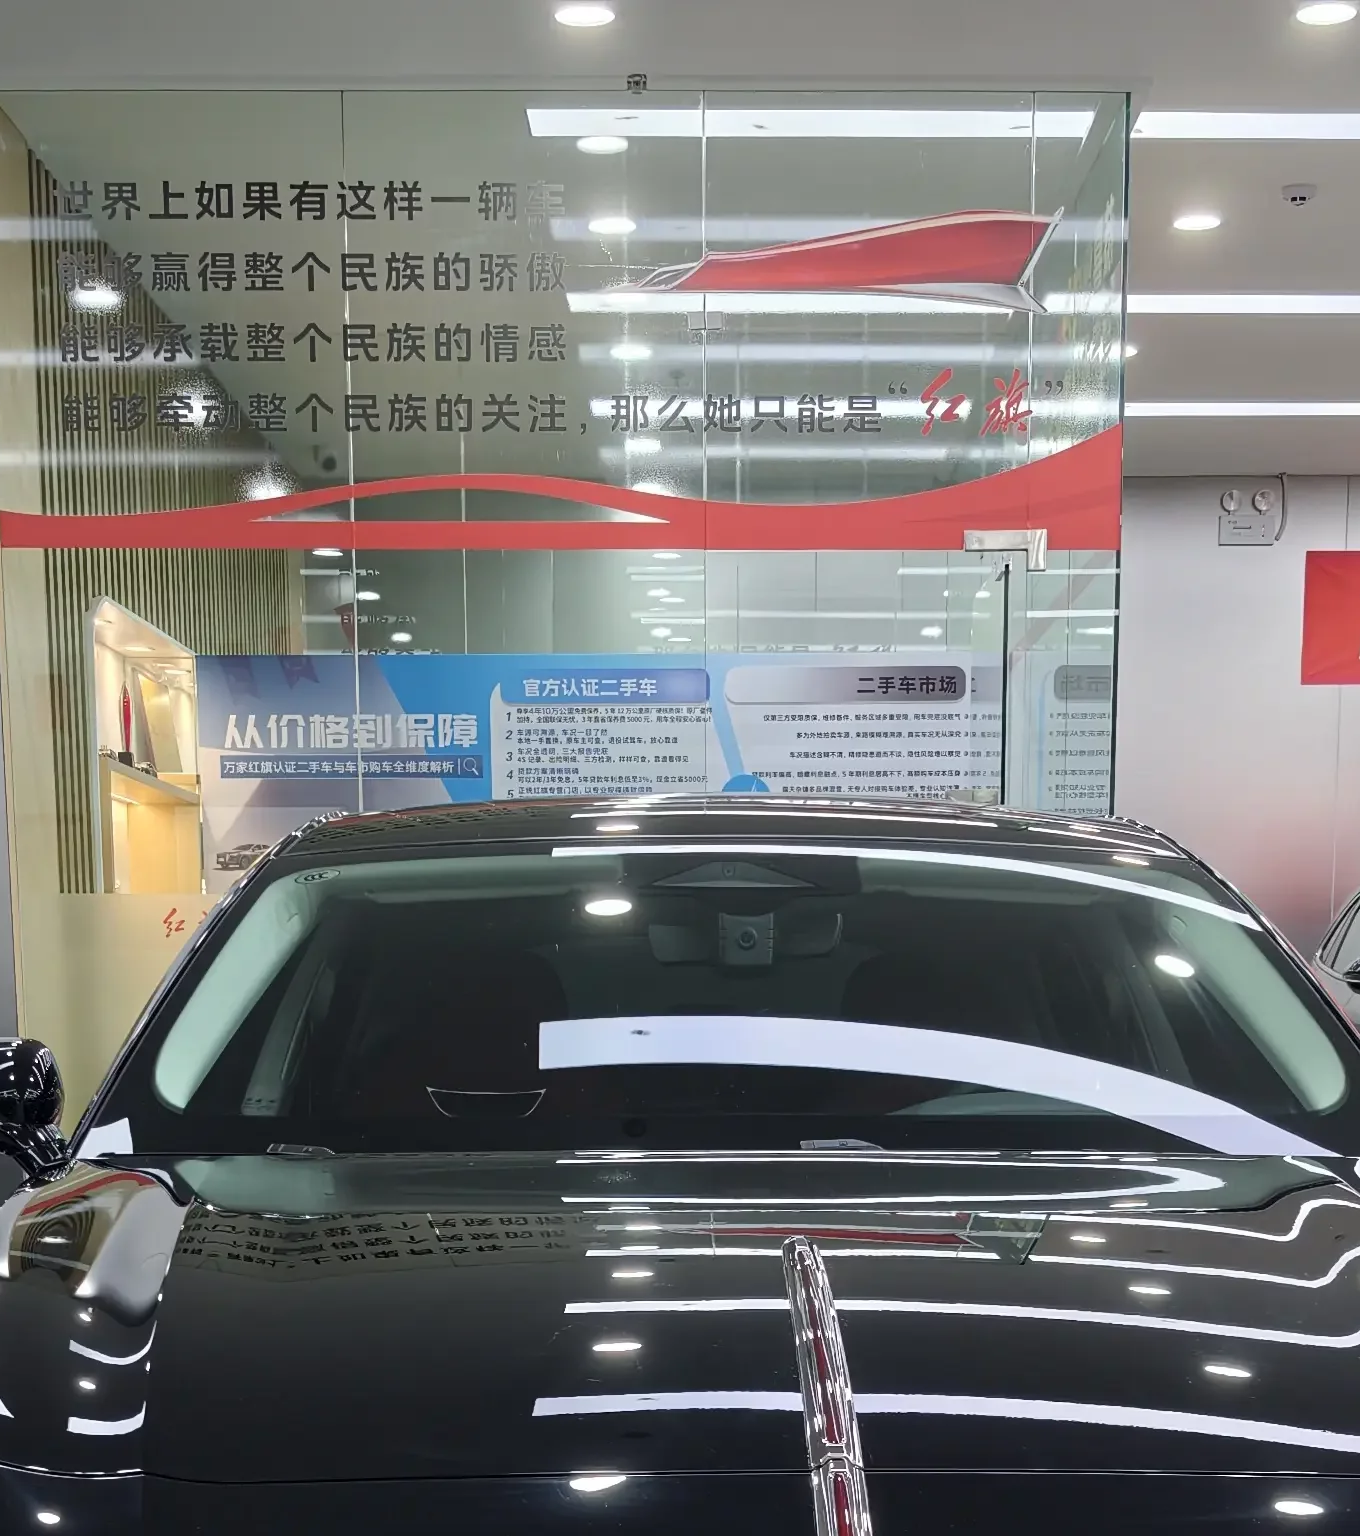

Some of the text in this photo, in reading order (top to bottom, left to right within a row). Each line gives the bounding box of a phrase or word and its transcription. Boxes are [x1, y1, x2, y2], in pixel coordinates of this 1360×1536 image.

[59, 180, 566, 222] 世界上如果有这样一辆车
[59, 251, 567, 293] 能够赢得整个民族的骄傲
[60, 322, 567, 364] 能够承载整个民族的情感
[522, 678, 658, 697] 官方认证二手车
[857, 676, 957, 694] 二手车市场
[224, 713, 479, 749] 从价格到保障
[162, 907, 209, 938] 红
